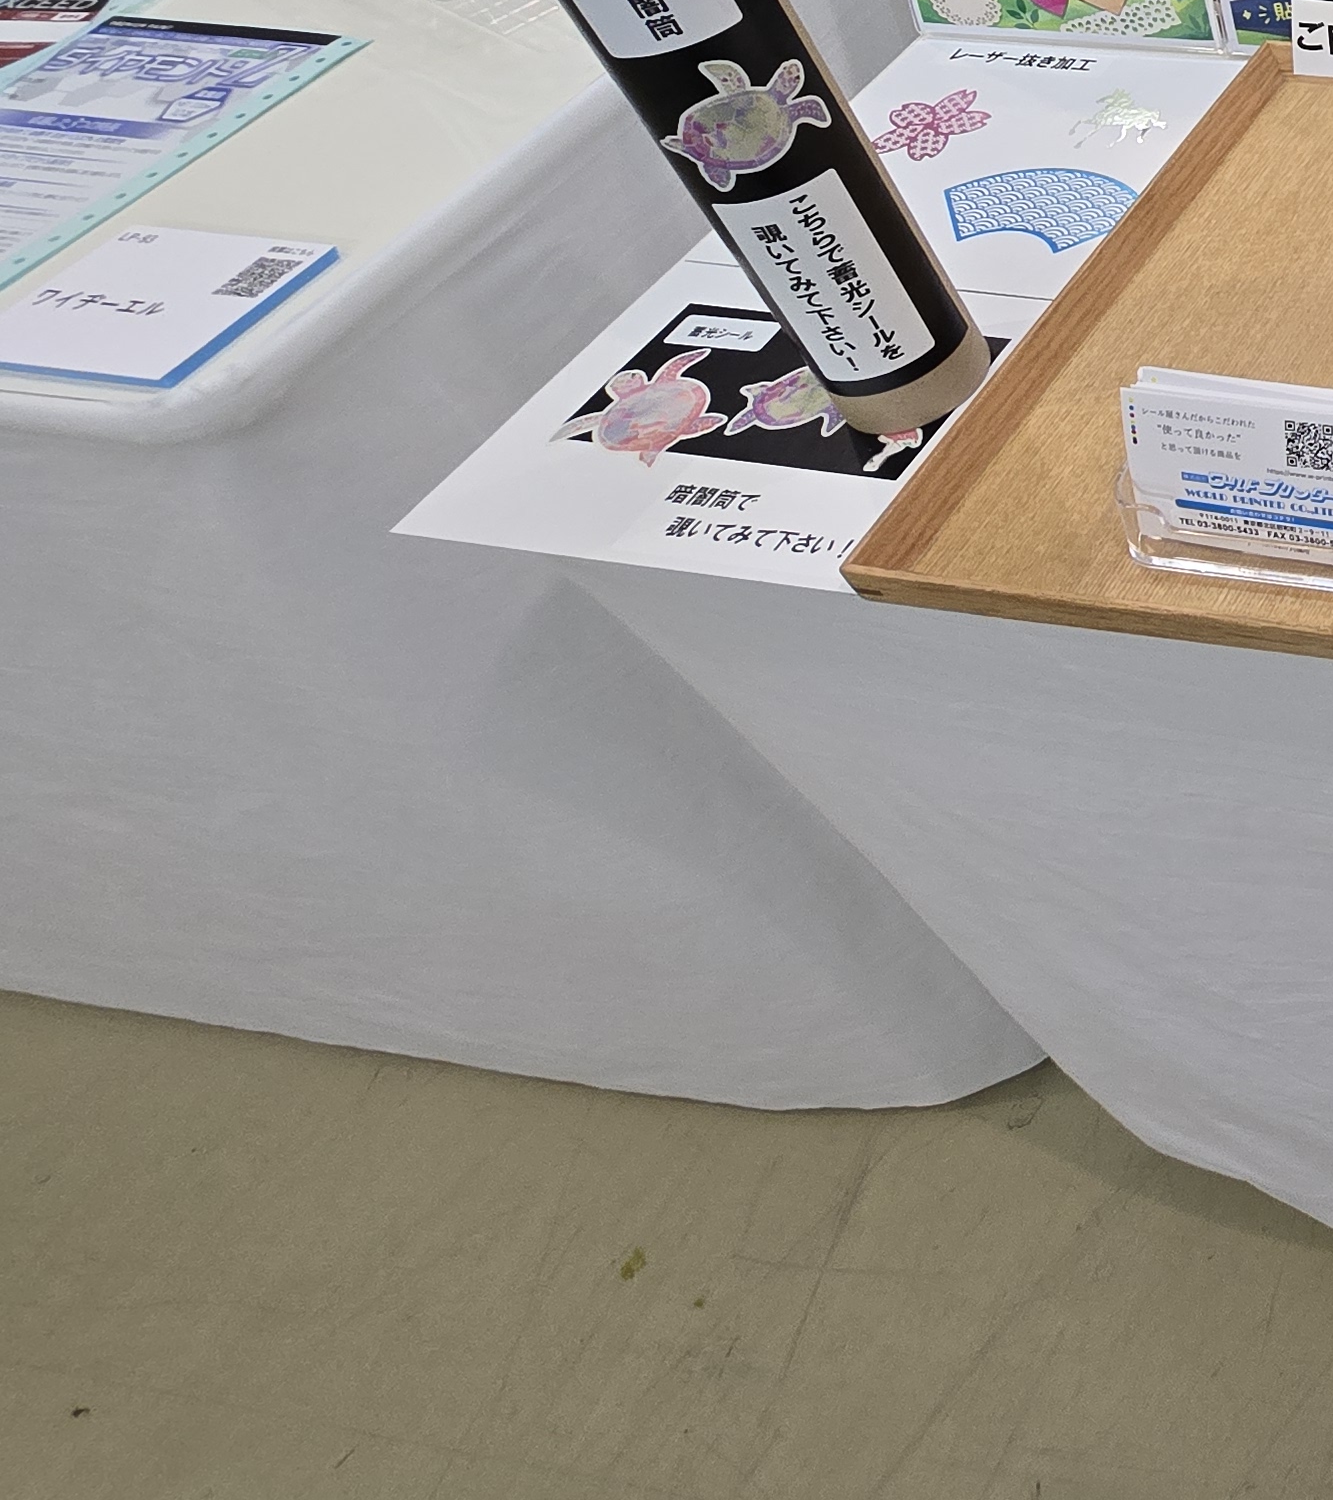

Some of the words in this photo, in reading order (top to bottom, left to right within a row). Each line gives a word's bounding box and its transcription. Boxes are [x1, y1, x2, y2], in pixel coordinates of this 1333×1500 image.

[949, 49, 1099, 73] レーザー抜き加工
[791, 193, 906, 361] こちらで蓄光シールを
[687, 324, 754, 345] 蓄光シール
[667, 481, 758, 511] 暗闇筒で
[1185, 488, 1228, 502] WORLD
[1232, 495, 1286, 510] PRINTER
[1179, 517, 1196, 527] TEL
[1267, 531, 1287, 541] FAX
